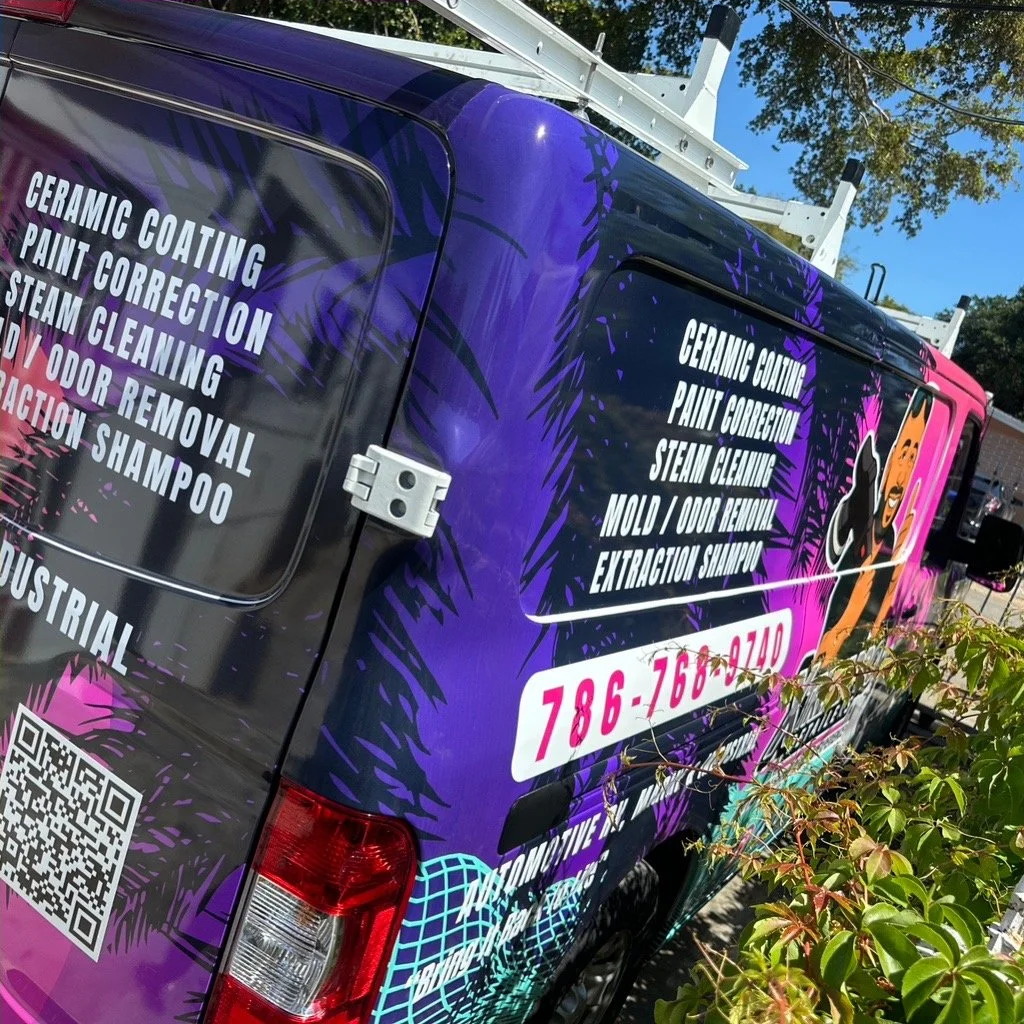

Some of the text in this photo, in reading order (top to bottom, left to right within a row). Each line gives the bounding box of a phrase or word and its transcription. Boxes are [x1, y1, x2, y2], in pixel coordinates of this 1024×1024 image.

[25, 171, 267, 290] CERAMIC COATING
[5, 270, 225, 399] STEAM CLEANING
[19, 222, 273, 356] PAINT CORRECTION
[23, 334, 42, 370] /
[46, 343, 113, 407] ODOR
[117, 376, 256, 478] REMOVAL
[678, 319, 807, 399] CERAMIC COATING
[649, 438, 777, 488] STEAM CLEANING
[667, 380, 801, 446] PAINT CORRECTION
[91, 423, 233, 525] SHAMPOO
[599, 494, 778, 538] MOLD / ODOR REMOVAL
[589, 541, 764, 594] EXTRACTION SHAMPOO
[535, 622, 784, 762] 786-768-9740
[455, 813, 601, 924] AUTOMOTIVE
